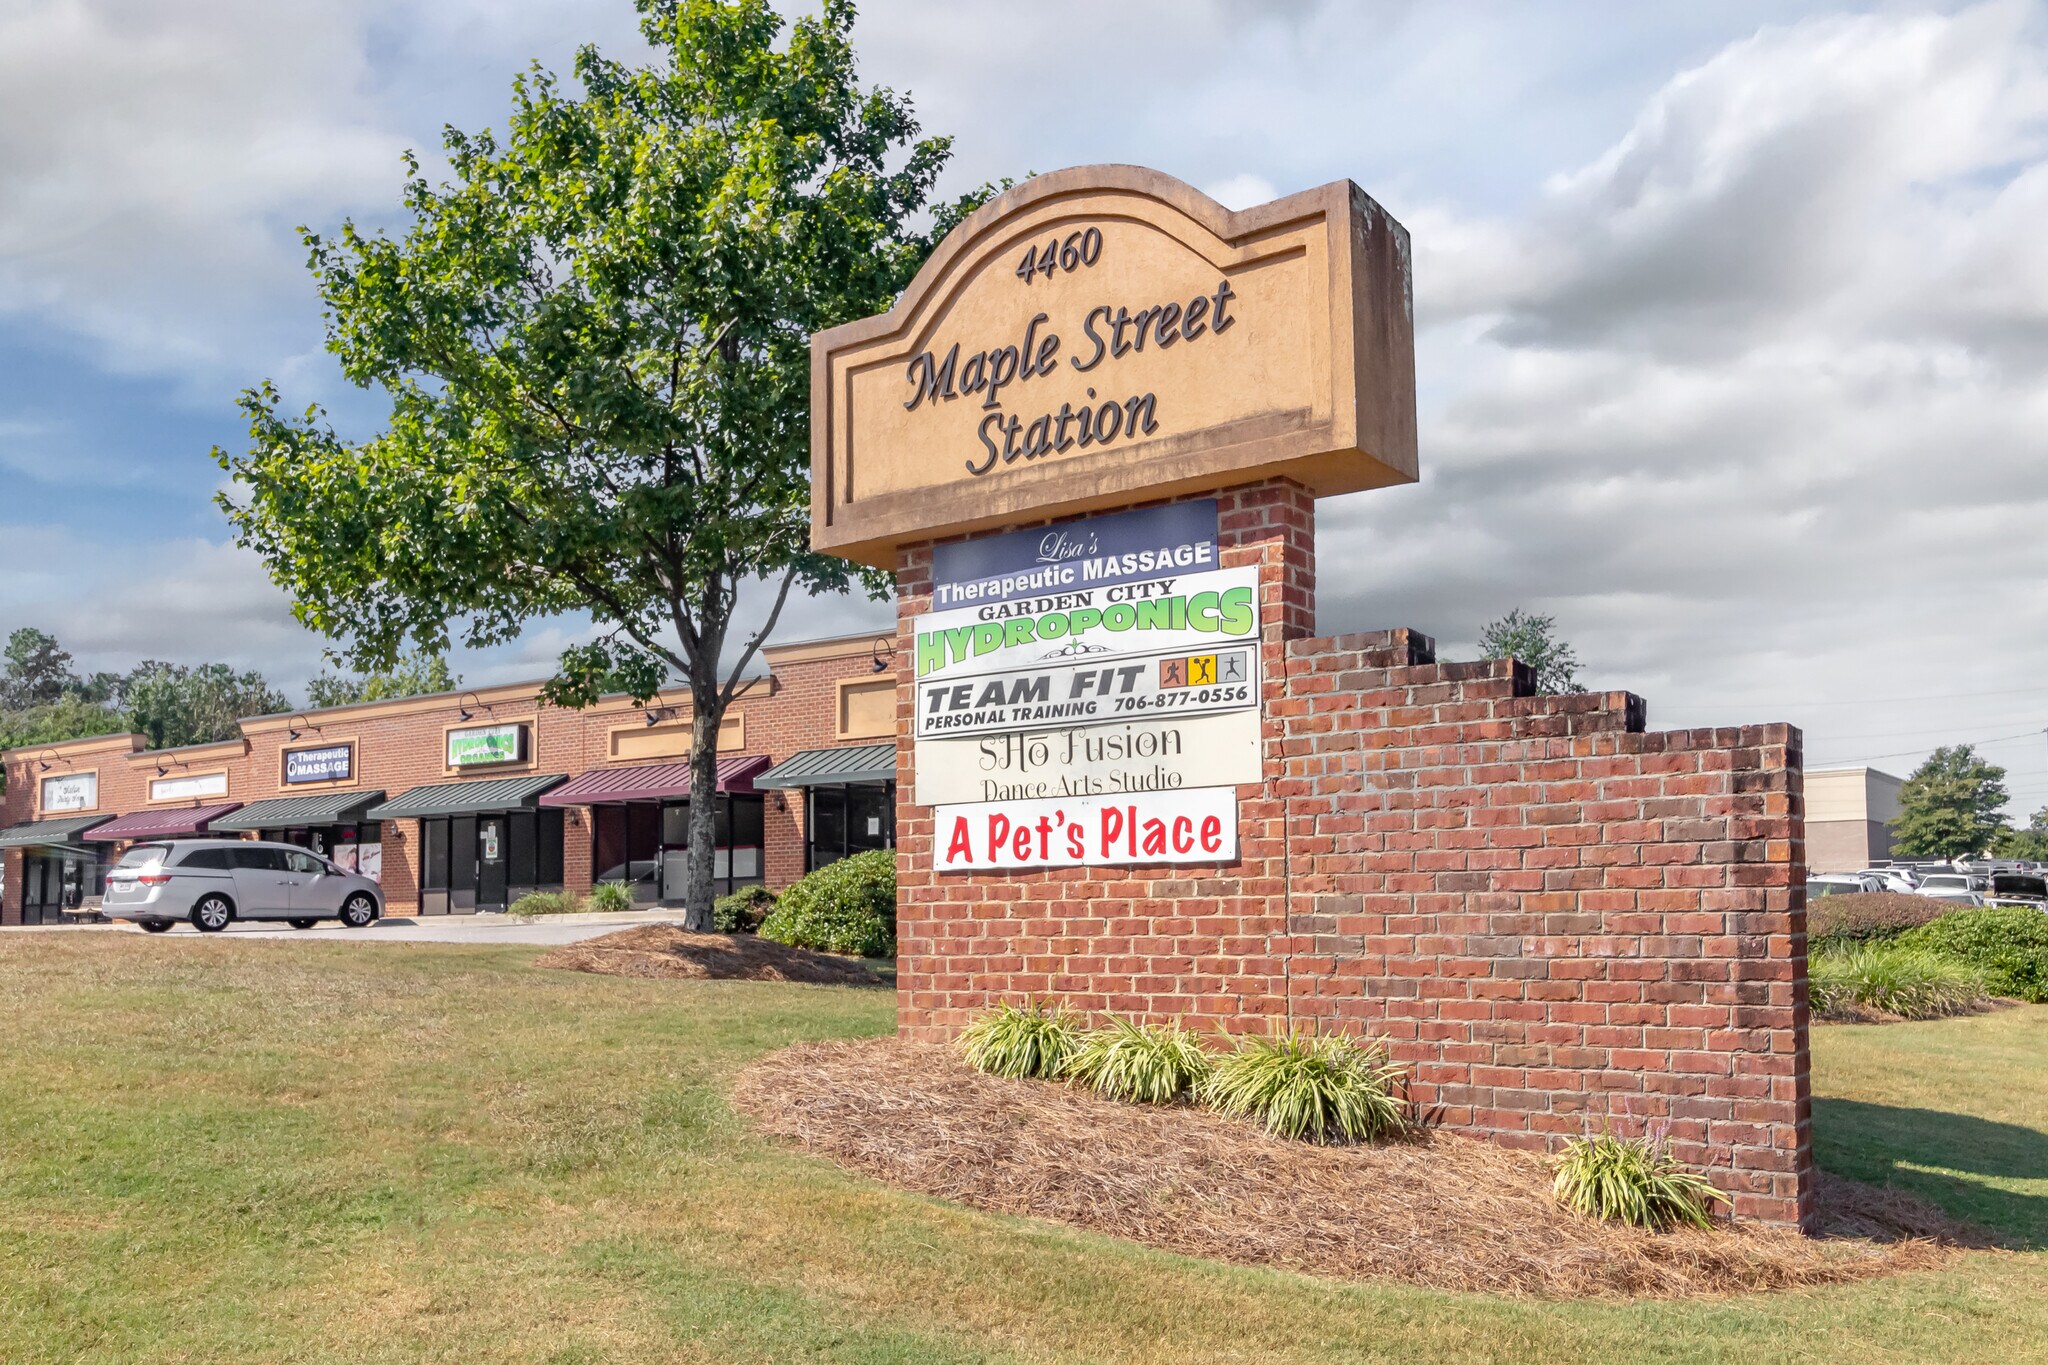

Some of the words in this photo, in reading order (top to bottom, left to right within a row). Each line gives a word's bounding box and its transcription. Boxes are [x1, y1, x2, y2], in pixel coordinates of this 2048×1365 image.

[1016, 227, 1102, 283] 4460
[903, 312, 1060, 410] Maple
[1070, 280, 1236, 372] Street
[966, 387, 1159, 475] Station
[1036, 532, 1098, 563] Lisa's
[937, 565, 1075, 604] Therapeutic
[1083, 541, 1212, 581] MASSAGE
[978, 592, 1094, 621] GARDEN
[1106, 579, 1176, 601] CITY
[917, 586, 1254, 678] HYDROPONICS
[925, 710, 1006, 730] PERSONAL
[1012, 701, 1097, 721] TRAINING
[1114, 686, 1249, 712] 706-877-0556
[927, 676, 1050, 714] TEAM
[1069, 665, 1146, 699] FIT
[297, 748, 349, 762] Therapeutic
[297, 760, 349, 776] MASSAGE
[1060, 725, 1182, 766] Fusion
[980, 778, 1047, 802] Dance
[1051, 774, 1103, 797] Arts
[1109, 765, 1182, 793] Studio
[946, 815, 973, 863] A
[988, 810, 1085, 863] Pet's
[1100, 805, 1223, 859] Place
